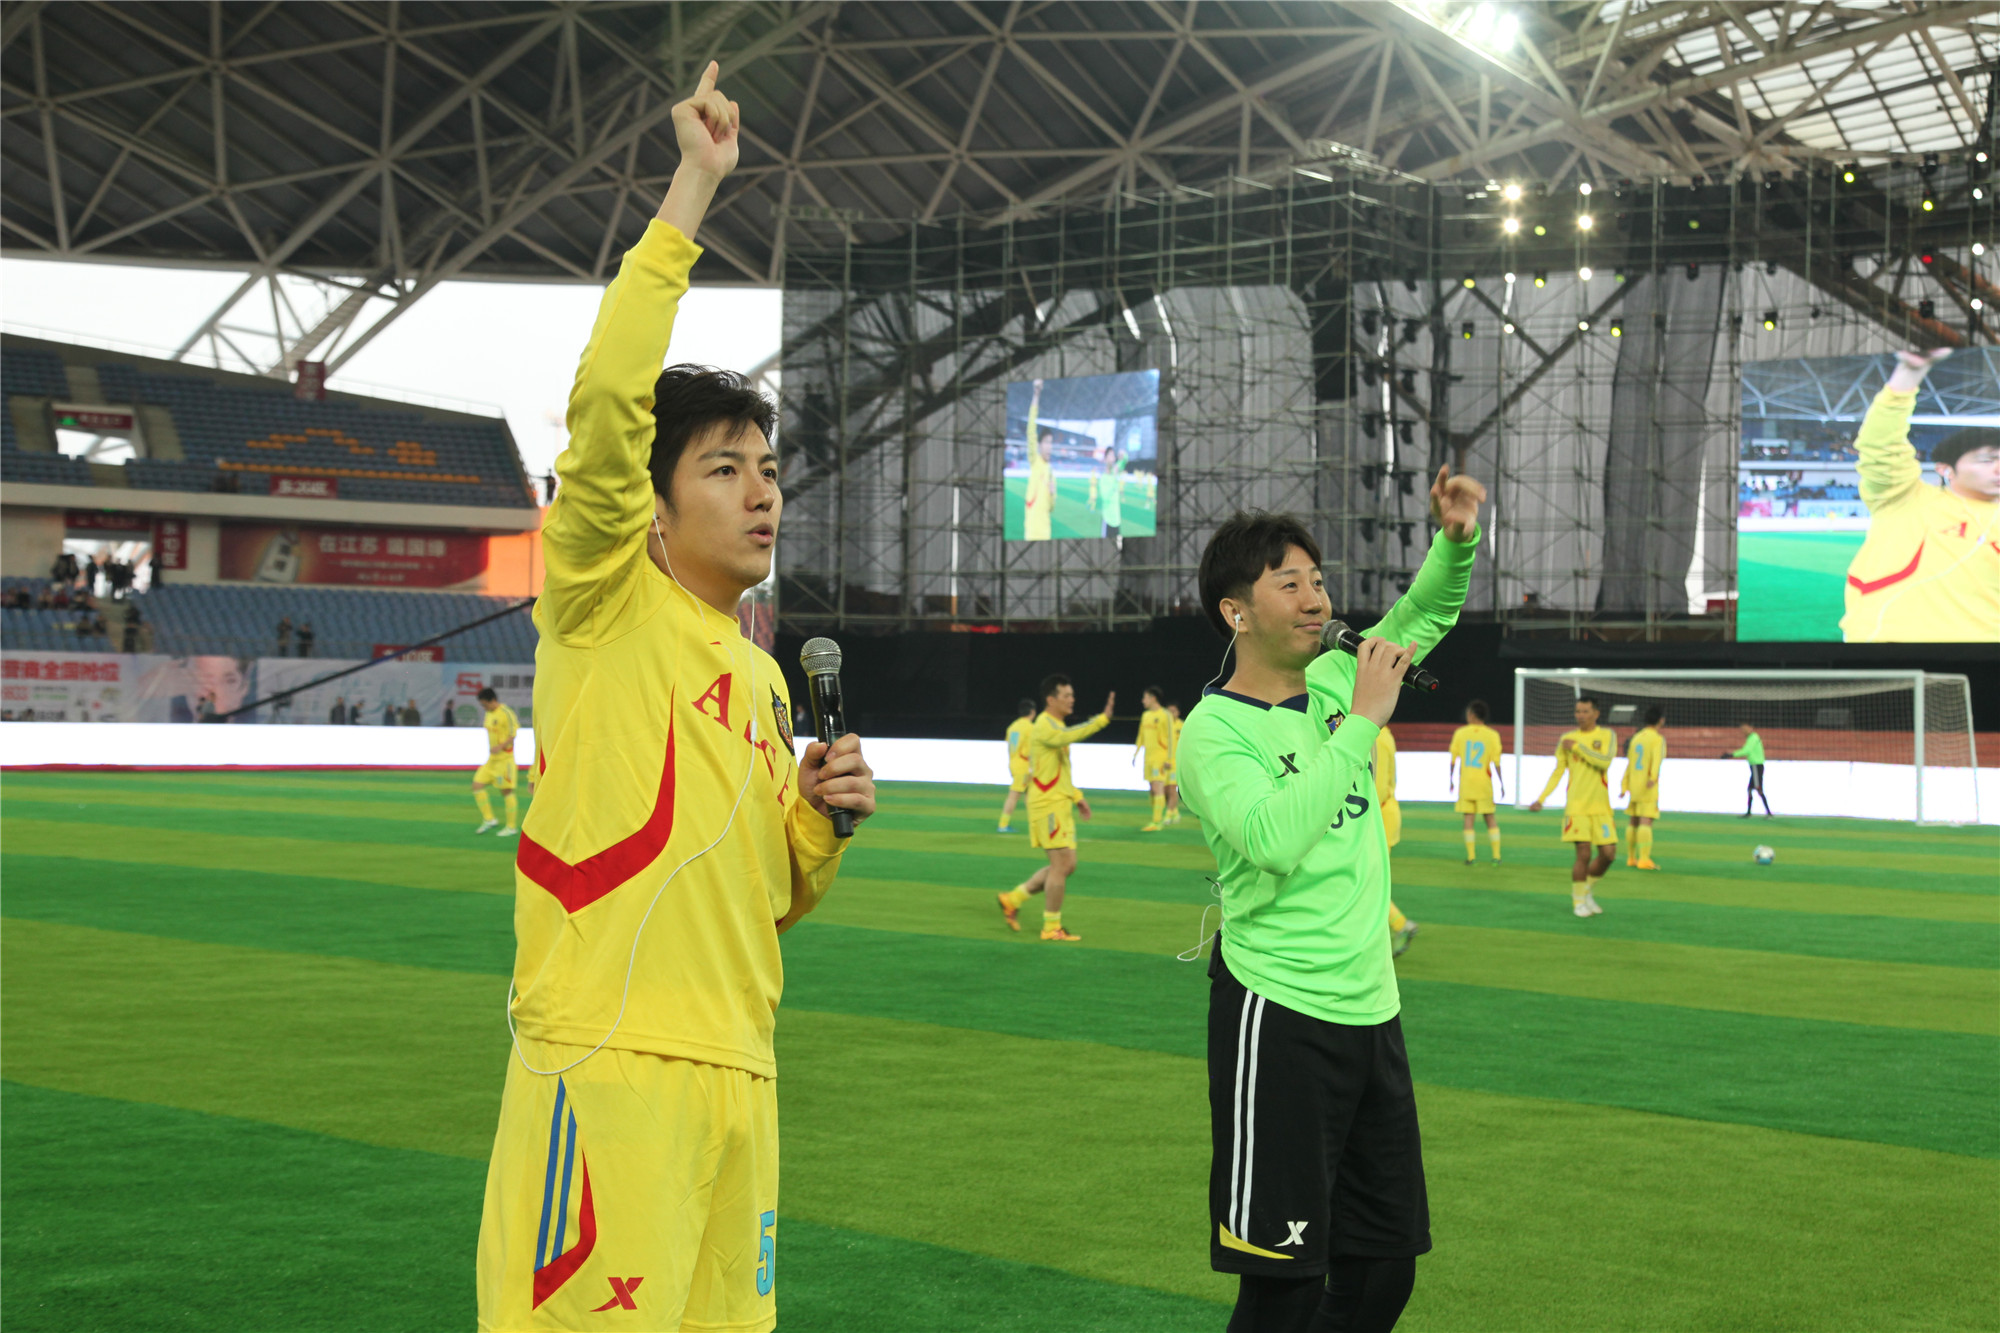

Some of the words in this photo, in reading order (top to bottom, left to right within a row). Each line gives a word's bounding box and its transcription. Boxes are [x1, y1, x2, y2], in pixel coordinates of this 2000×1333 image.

[1464, 740, 1485, 768] 12
[1634, 743, 1644, 771] 2
[756, 1209, 775, 1297] 5
